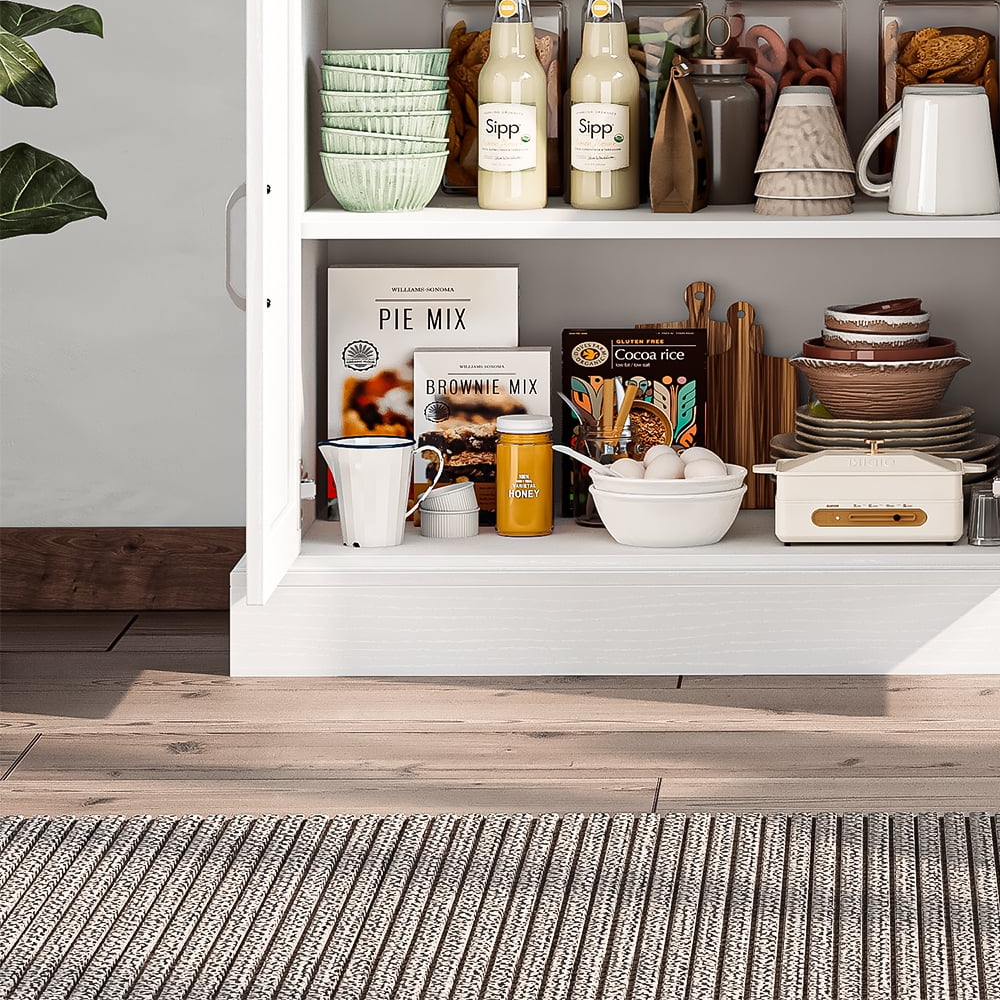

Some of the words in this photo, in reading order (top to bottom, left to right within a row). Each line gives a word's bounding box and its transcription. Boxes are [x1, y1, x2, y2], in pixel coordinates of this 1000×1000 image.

[486, 118, 520, 139] Sipp
[579, 118, 613, 139] Sipp
[379, 308, 414, 330] PIE
[427, 308, 466, 330] MIX
[614, 348, 657, 361] Cocoa
[660, 349, 685, 361] rice
[426, 379, 500, 395] BROWNIE
[509, 379, 538, 395] MIX
[508, 489, 540, 498] HONEY
